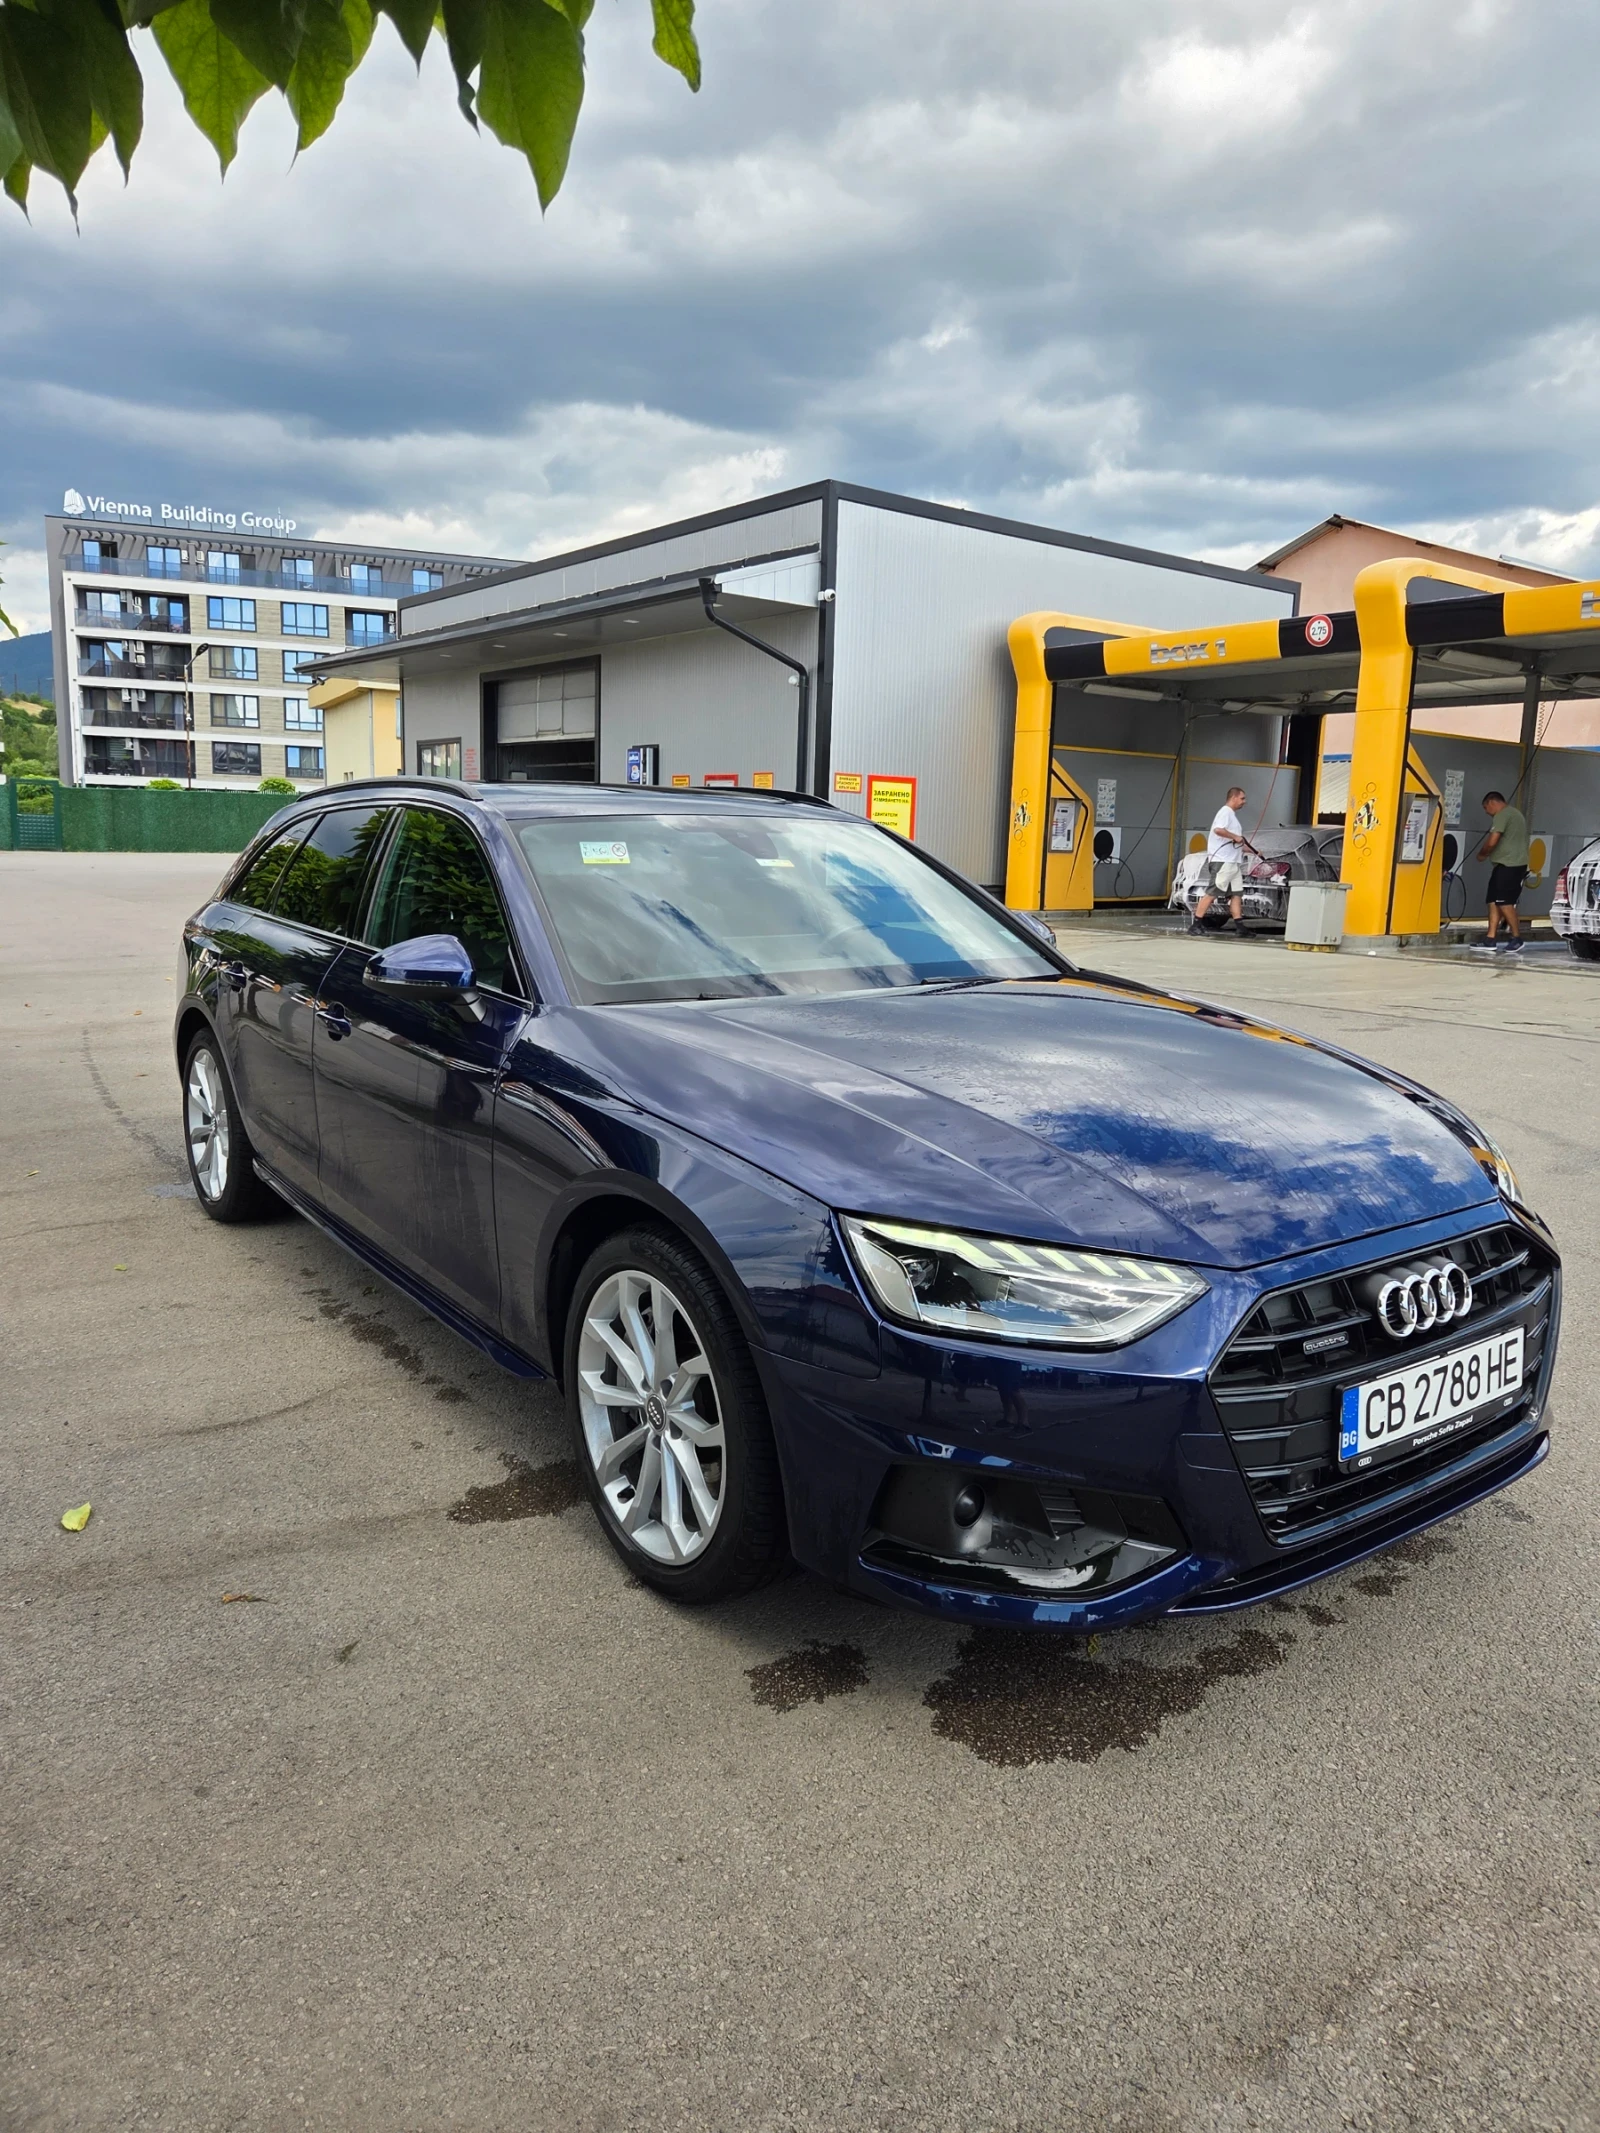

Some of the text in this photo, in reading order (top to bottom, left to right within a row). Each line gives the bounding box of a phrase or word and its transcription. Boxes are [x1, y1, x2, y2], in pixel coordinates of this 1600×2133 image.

[87, 496, 297, 534] Vienna Building Group
[1311, 626, 1327, 636] 2.75
[1151, 639, 1226, 664] box 1
[873, 790, 910, 798] ЗАБРАНЕНО
[1305, 1336, 1345, 1352] quattro
[1365, 1337, 1519, 1440] CB 2788 HE
[1342, 1429, 1357, 1449] BG
[1412, 1415, 1474, 1447] Porsche Sofia Zapad
